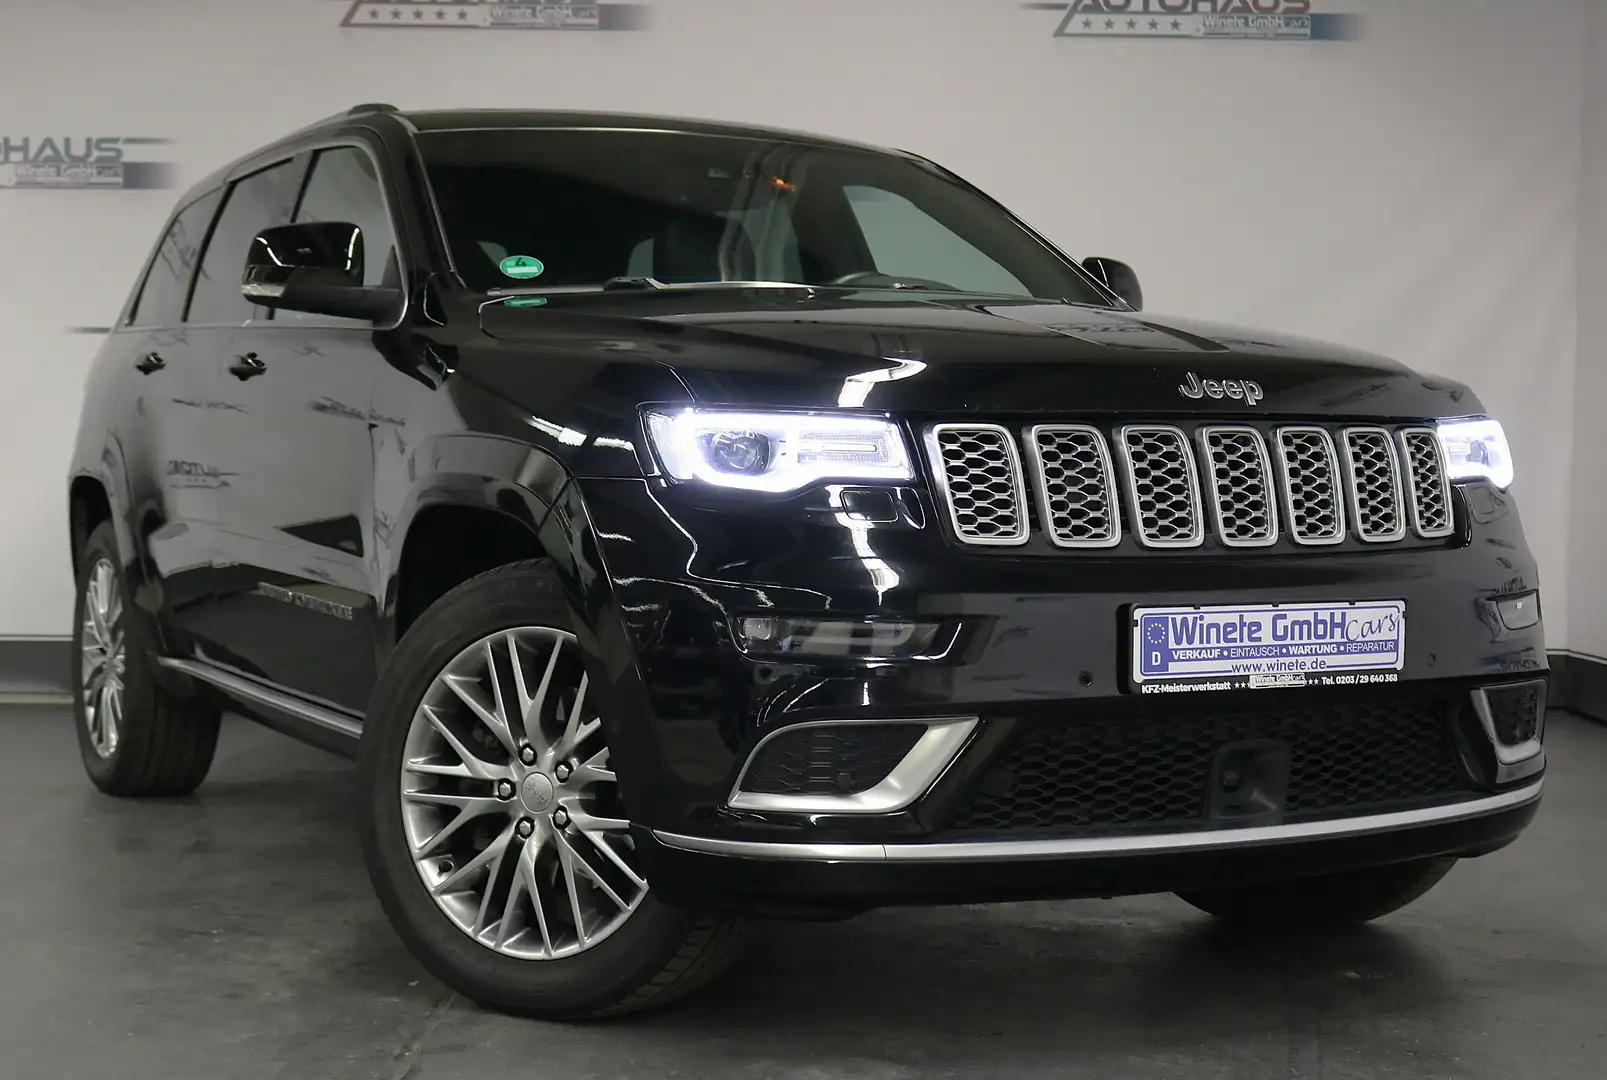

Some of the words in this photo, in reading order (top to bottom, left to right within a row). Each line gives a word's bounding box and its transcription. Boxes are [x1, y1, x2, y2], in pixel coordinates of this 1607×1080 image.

[0, 136, 124, 164] HAUS
[1178, 371, 1264, 406] Jeep
[1170, 614, 1262, 646] Winete
[1271, 611, 1347, 642] GmbH
[1151, 651, 1162, 666] D
[1171, 648, 1221, 660] VERKAUF
[1230, 645, 1280, 658] EINTAUSCH
[1288, 643, 1338, 656] WARTUNG
[1346, 641, 1395, 653] REPARATUR
[1231, 657, 1327, 674] www.winete.de
[1141, 681, 1232, 694] KFZ-Meisterwerkstatt
[1321, 675, 1336, 685] Tel.
